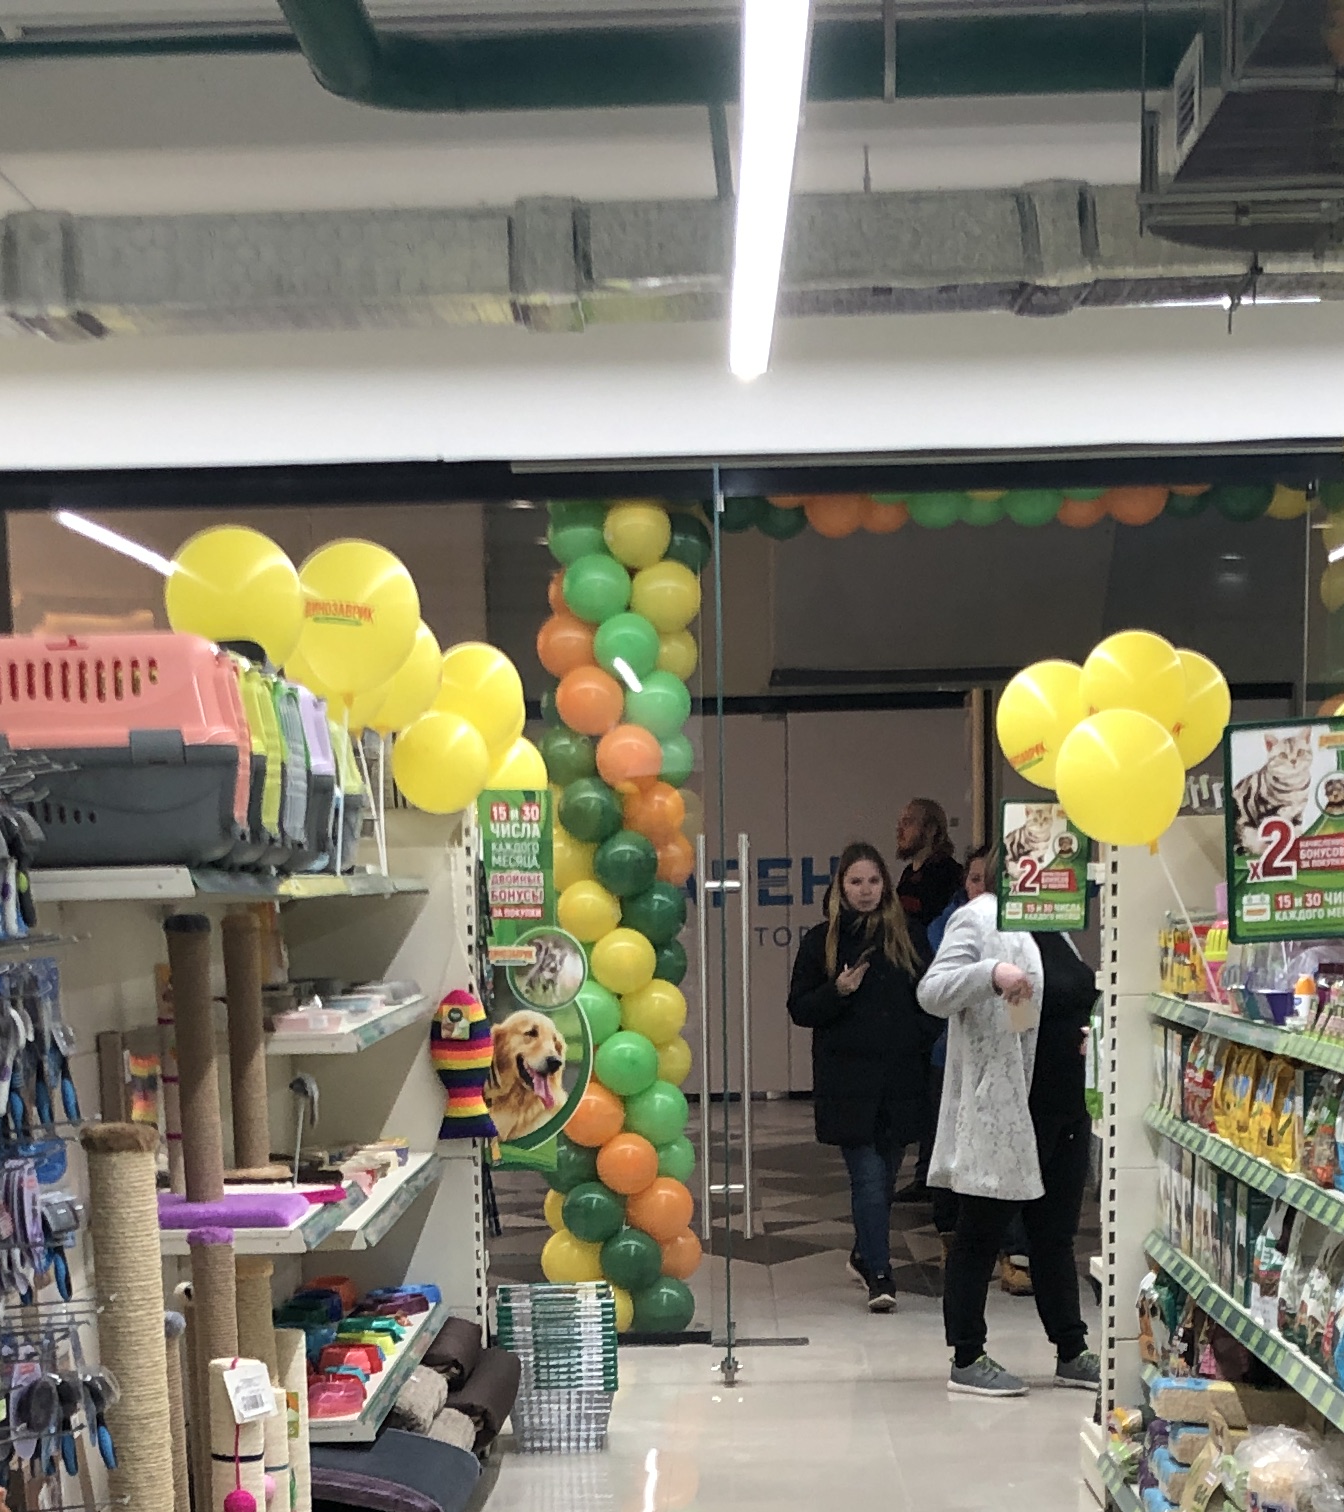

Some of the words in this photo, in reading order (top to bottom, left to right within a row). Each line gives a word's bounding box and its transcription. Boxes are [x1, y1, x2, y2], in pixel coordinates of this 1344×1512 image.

[492, 805, 507, 821] 15
[521, 805, 540, 821] 30
[490, 823, 542, 838] ЧИСЛА
[490, 888, 543, 901] БОНУСЫ
[1276, 894, 1292, 909] 15
[1305, 893, 1322, 907] 30
[1275, 908, 1325, 922] КАЖДОГО
